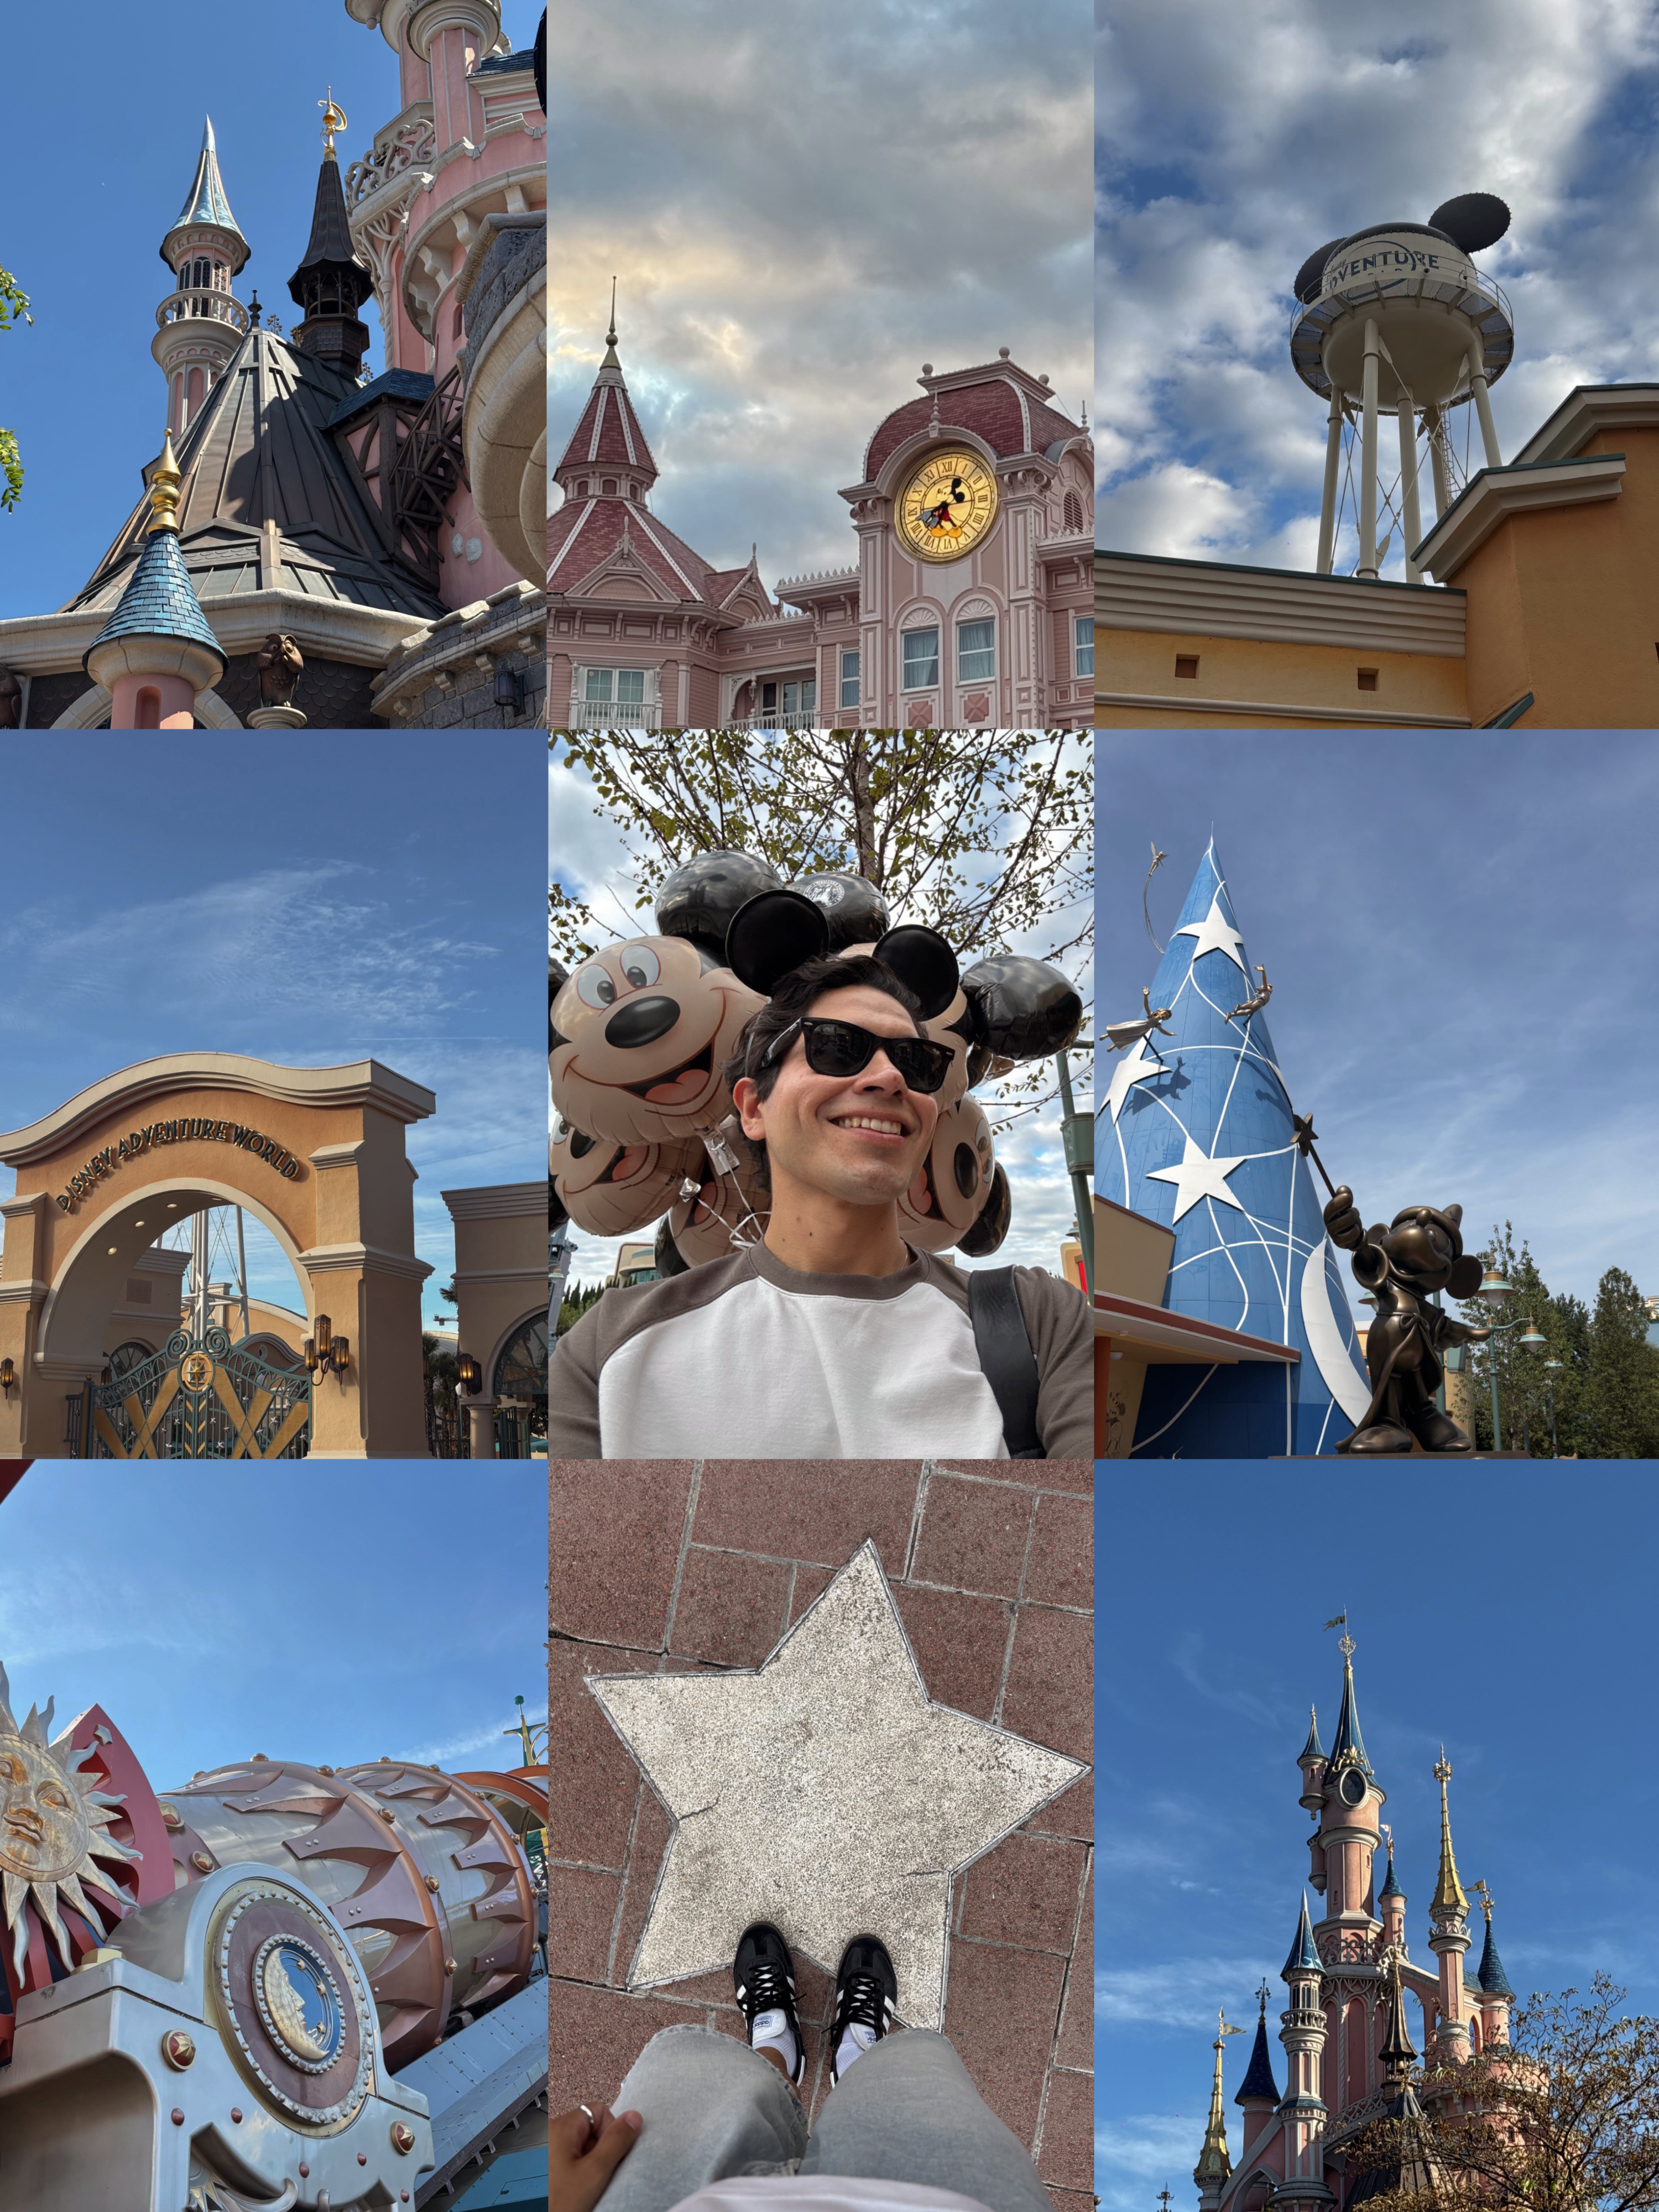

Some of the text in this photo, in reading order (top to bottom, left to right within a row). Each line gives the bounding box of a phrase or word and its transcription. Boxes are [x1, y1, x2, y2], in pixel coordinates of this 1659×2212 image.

[1326, 251, 1439, 293] DVENTURE
[942, 461, 952, 473] XII
[924, 469, 935, 482] XI
[973, 476, 983, 484] II
[912, 488, 922, 496] X
[978, 494, 988, 503] III
[908, 507, 917, 517] IX
[972, 513, 984, 525] IIII
[911, 522, 923, 538] VIII
[924, 536, 935, 548] VII
[944, 539, 952, 549] VI
[55, 1118, 300, 1213] DISNEY ADVENTURE WORLD
